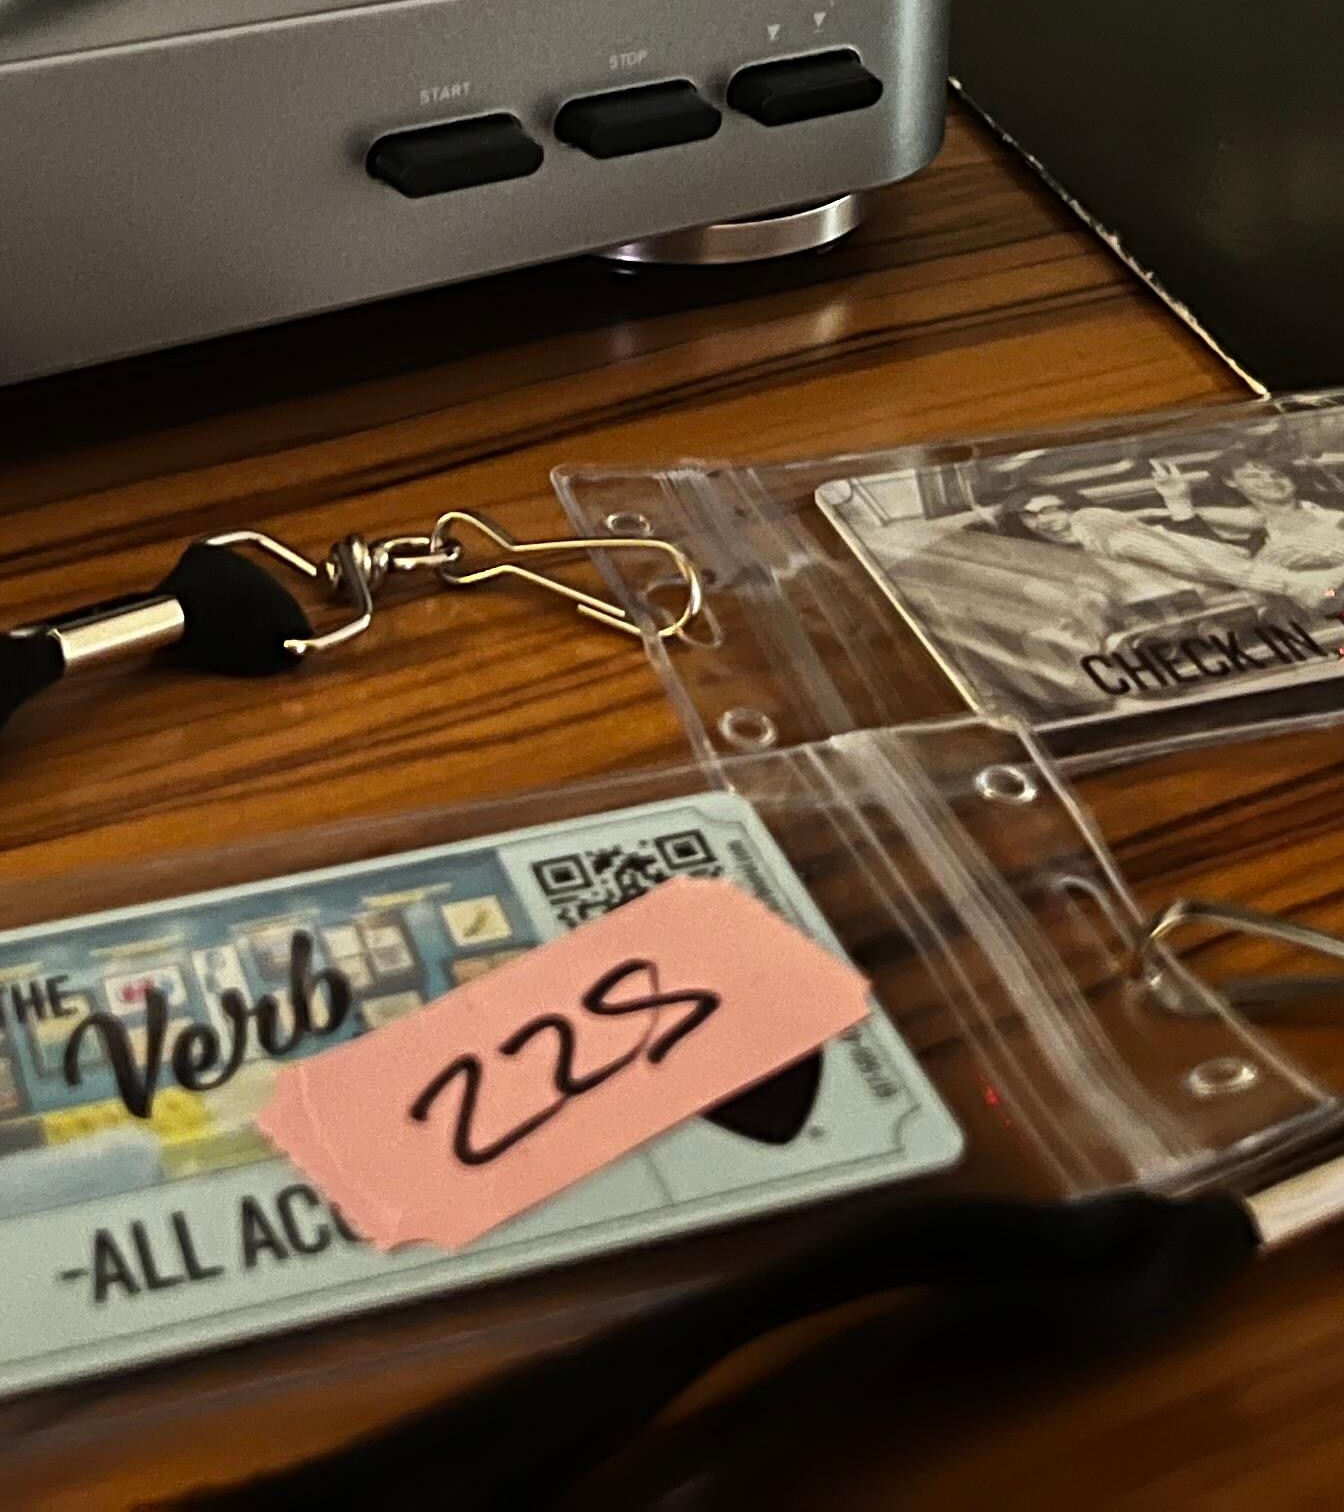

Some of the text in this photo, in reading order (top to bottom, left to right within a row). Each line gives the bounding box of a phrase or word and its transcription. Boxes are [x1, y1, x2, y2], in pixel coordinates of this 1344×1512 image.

[608, 49, 648, 70] STOP
[419, 81, 472, 106] START
[1079, 630, 1263, 696] CHECK
[62, 928, 353, 1120] Verb
